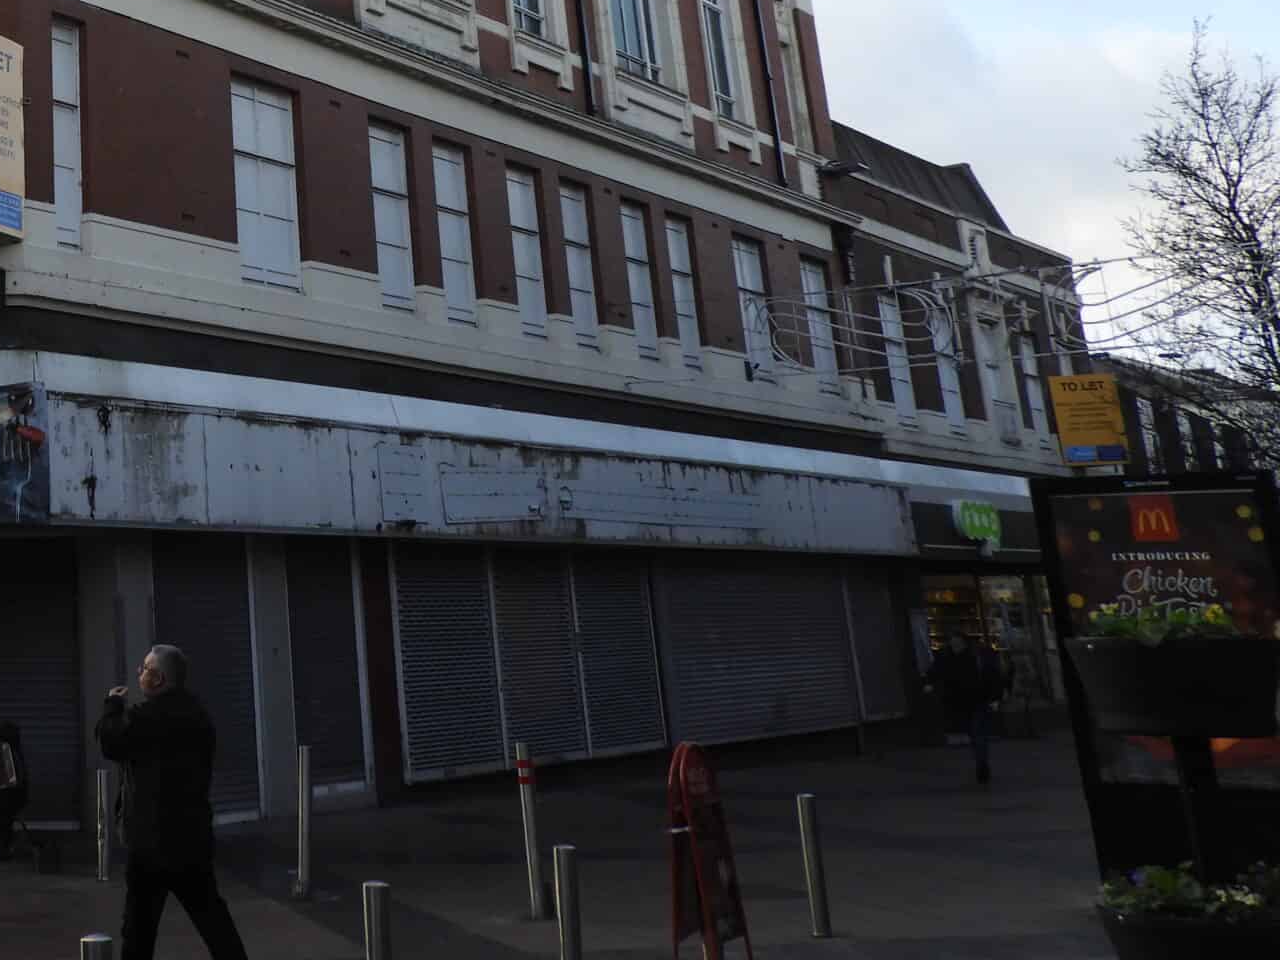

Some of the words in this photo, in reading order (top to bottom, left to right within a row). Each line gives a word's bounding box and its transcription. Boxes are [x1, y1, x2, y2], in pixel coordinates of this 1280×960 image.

[1059, 381, 1078, 392] TO
[1081, 380, 1105, 392] LET
[1111, 550, 1212, 561] INTRODUCING
[1122, 565, 1219, 599] Chicken
